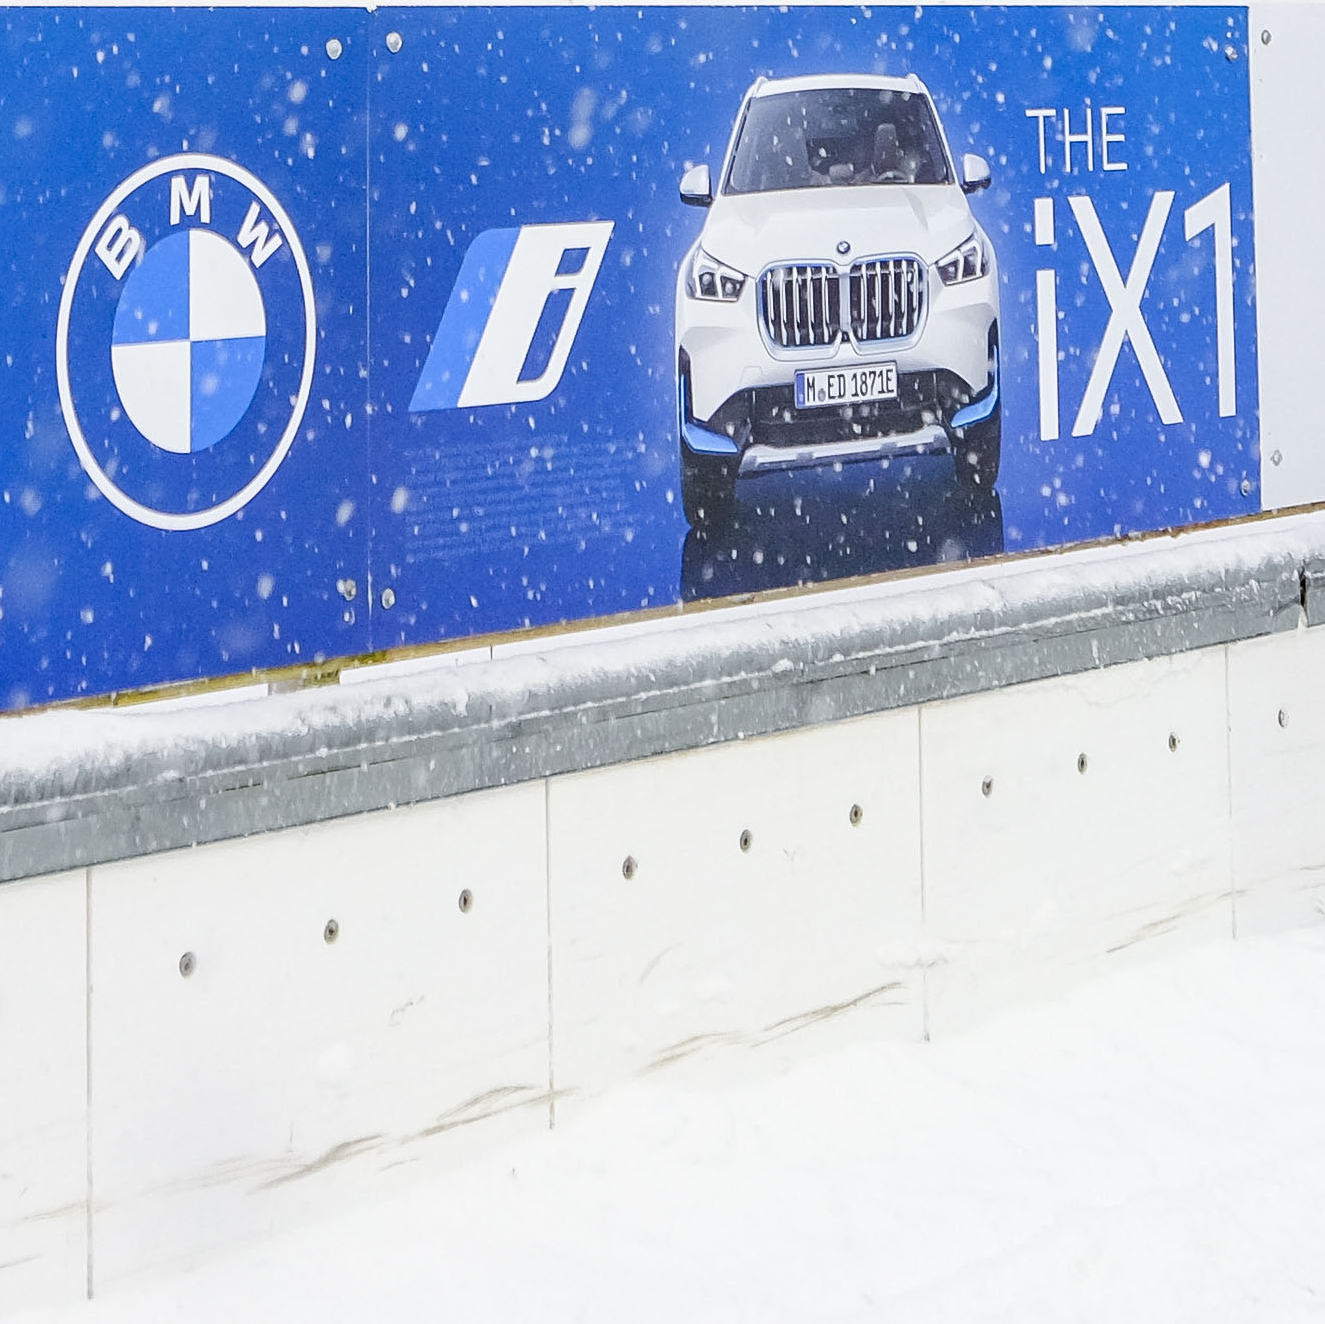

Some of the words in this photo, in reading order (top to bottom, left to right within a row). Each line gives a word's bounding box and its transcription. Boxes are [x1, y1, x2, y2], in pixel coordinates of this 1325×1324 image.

[1026, 106, 1128, 174] THE
[94, 174, 284, 281] BMW
[1034, 182, 1237, 442] iX1
[851, 368, 895, 397] 1871E
